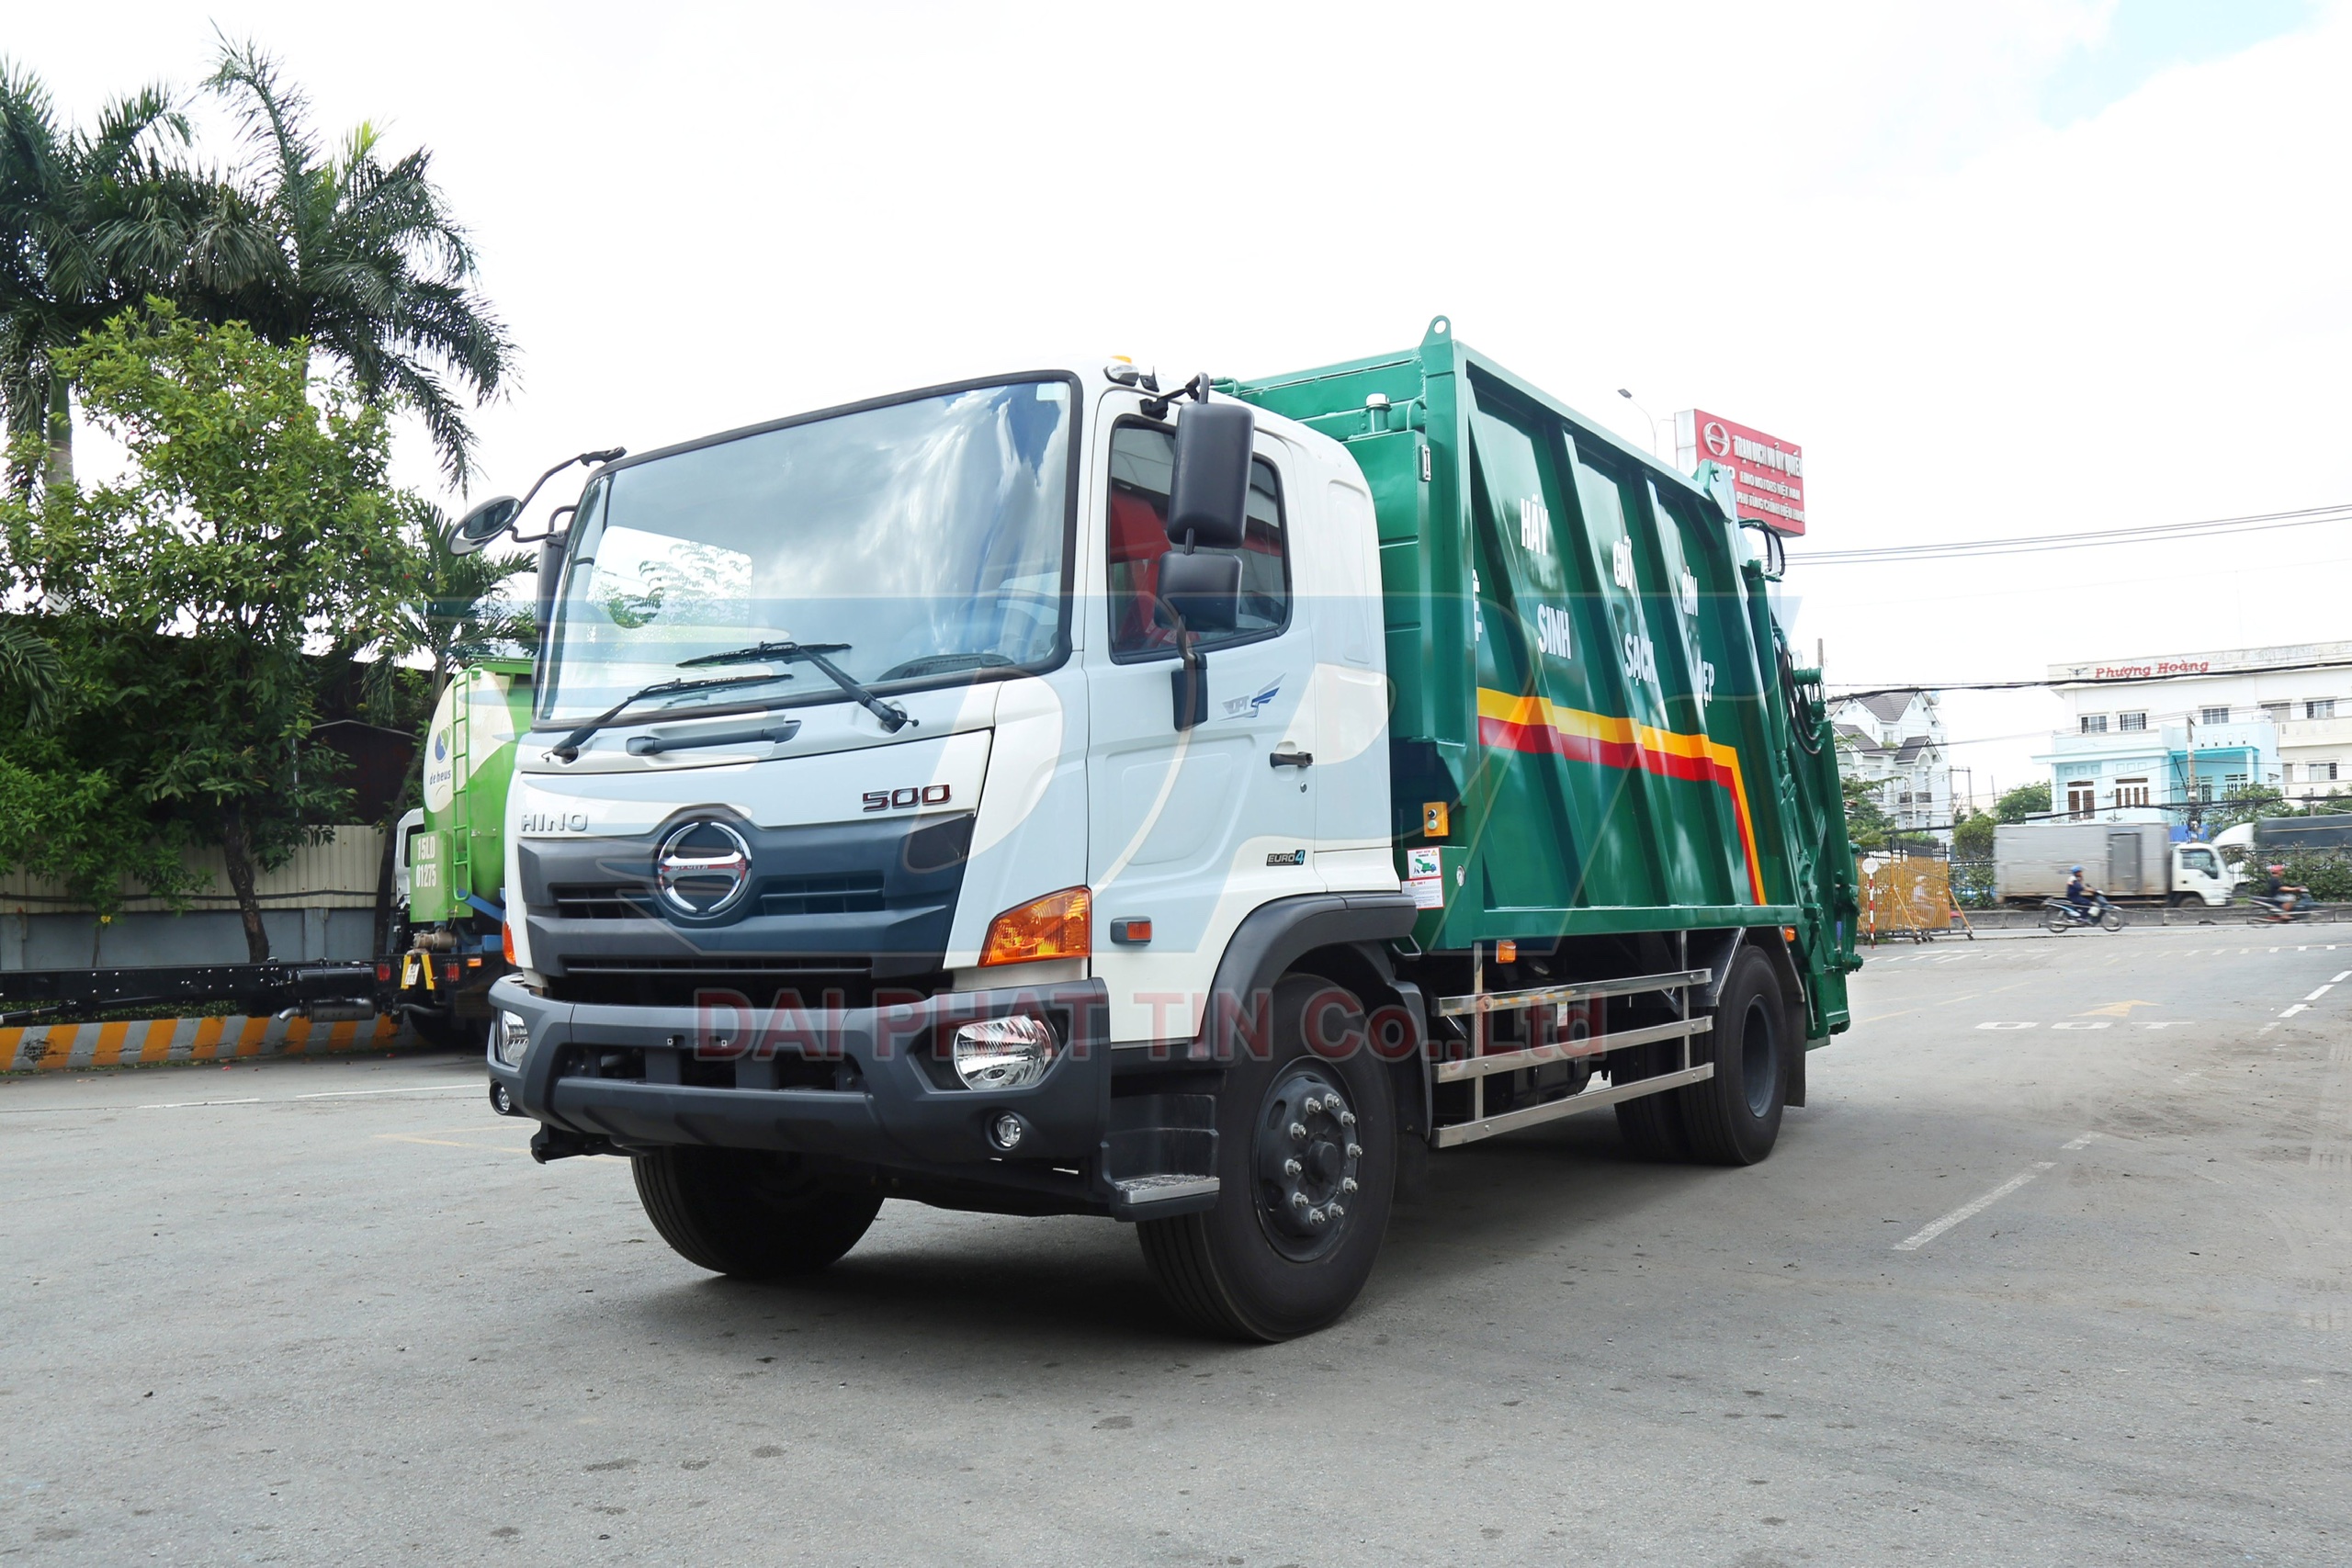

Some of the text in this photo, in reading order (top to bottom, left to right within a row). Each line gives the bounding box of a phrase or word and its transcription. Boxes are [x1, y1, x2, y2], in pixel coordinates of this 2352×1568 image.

[1521, 493, 1699, 616] HÃY GIỮ GÌN
[1537, 603, 1572, 660] SINH
[2095, 660, 2210, 678] Phượng Hoàng
[862, 783, 953, 812] 500
[521, 811, 589, 832] HINO
[417, 836, 436, 861] 15LD
[415, 863, 436, 888] 01275
